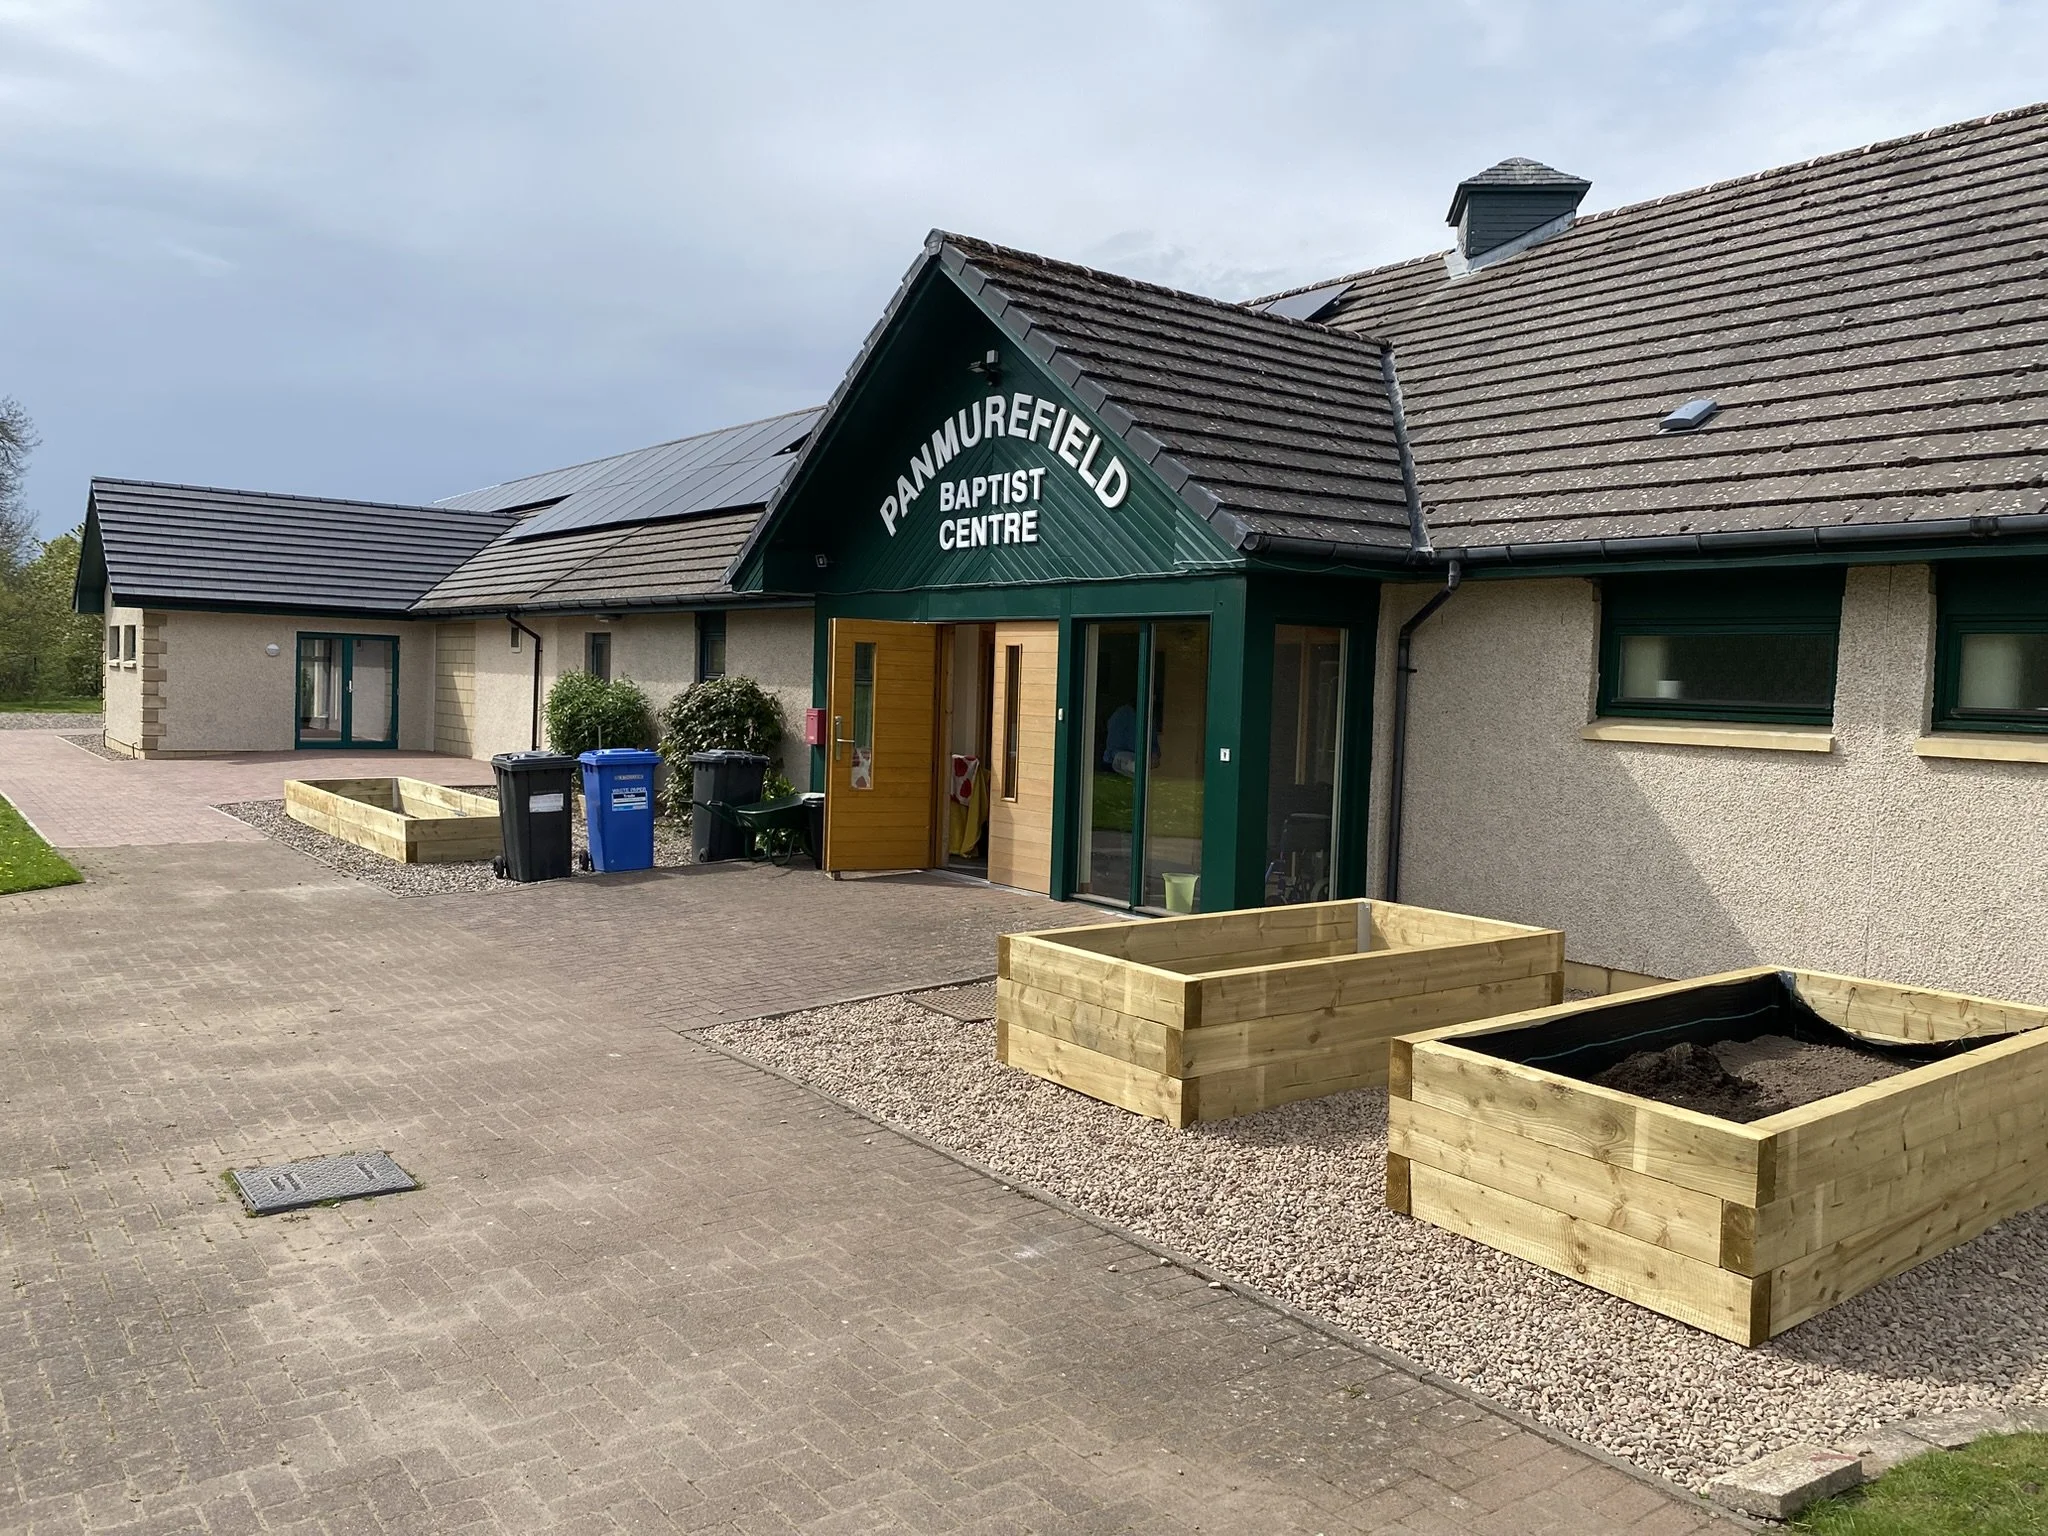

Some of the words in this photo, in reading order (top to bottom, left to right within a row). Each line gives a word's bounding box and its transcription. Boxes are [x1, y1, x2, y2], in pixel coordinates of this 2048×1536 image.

[880, 392, 1129, 537] PANMUREFIELD
[940, 467, 1046, 511] BAPTIST
[939, 510, 1038, 550] CENTRE
